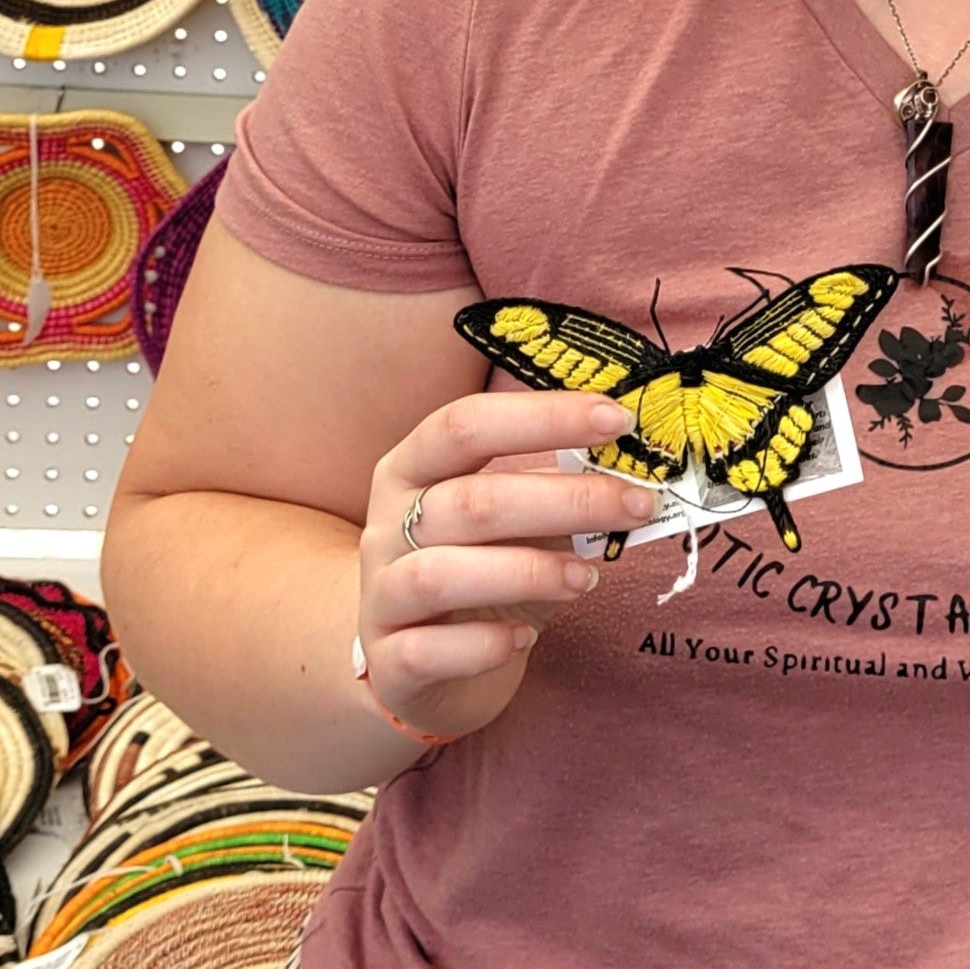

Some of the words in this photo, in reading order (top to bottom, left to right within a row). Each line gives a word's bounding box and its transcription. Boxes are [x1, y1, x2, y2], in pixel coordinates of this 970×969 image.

[639, 631, 675, 657] All
[684, 638, 755, 665] Your
[763, 645, 886, 677] Spiritual
[896, 656, 948, 681] and
